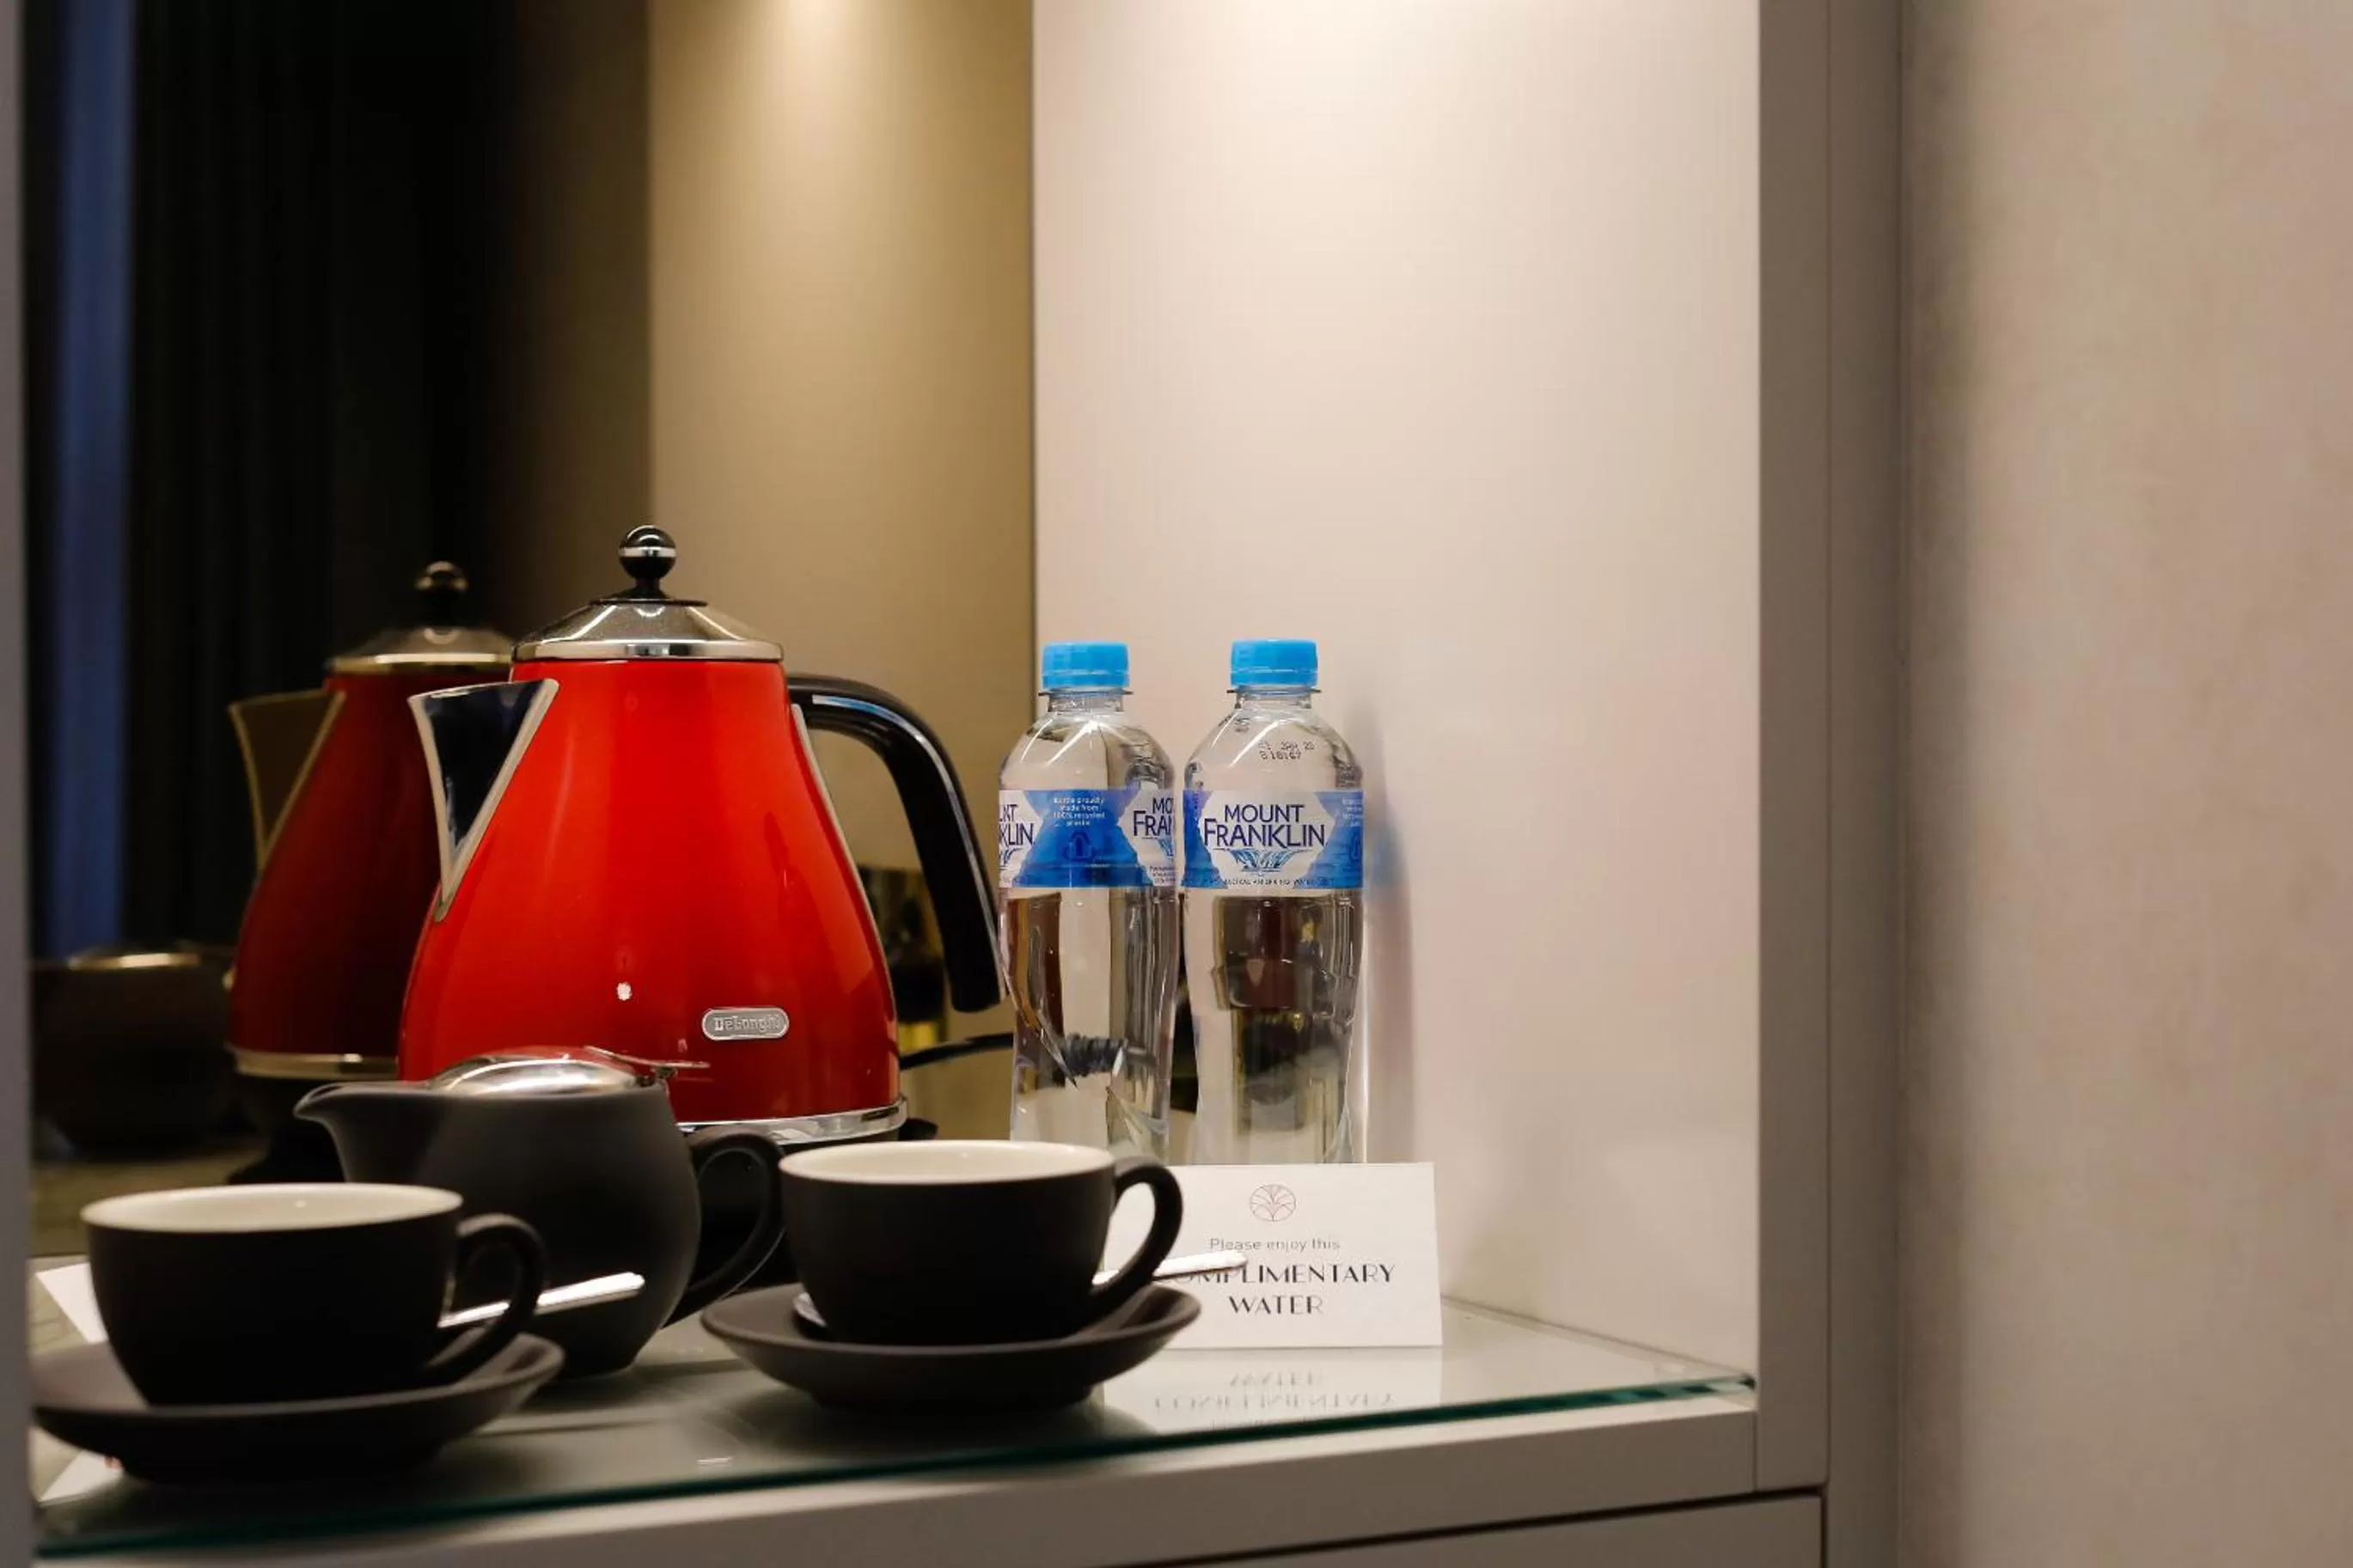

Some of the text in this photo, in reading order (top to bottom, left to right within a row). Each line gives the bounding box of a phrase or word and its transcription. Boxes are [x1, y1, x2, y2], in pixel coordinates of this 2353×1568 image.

[1224, 803, 1305, 822] MOUNT
[1204, 818, 1325, 848] FRANKLIN
[1210, 1238, 1341, 1253] Please enjoy this
[1177, 1264, 1395, 1283] MPLIMENTARY
[1229, 1296, 1323, 1315] WATER
